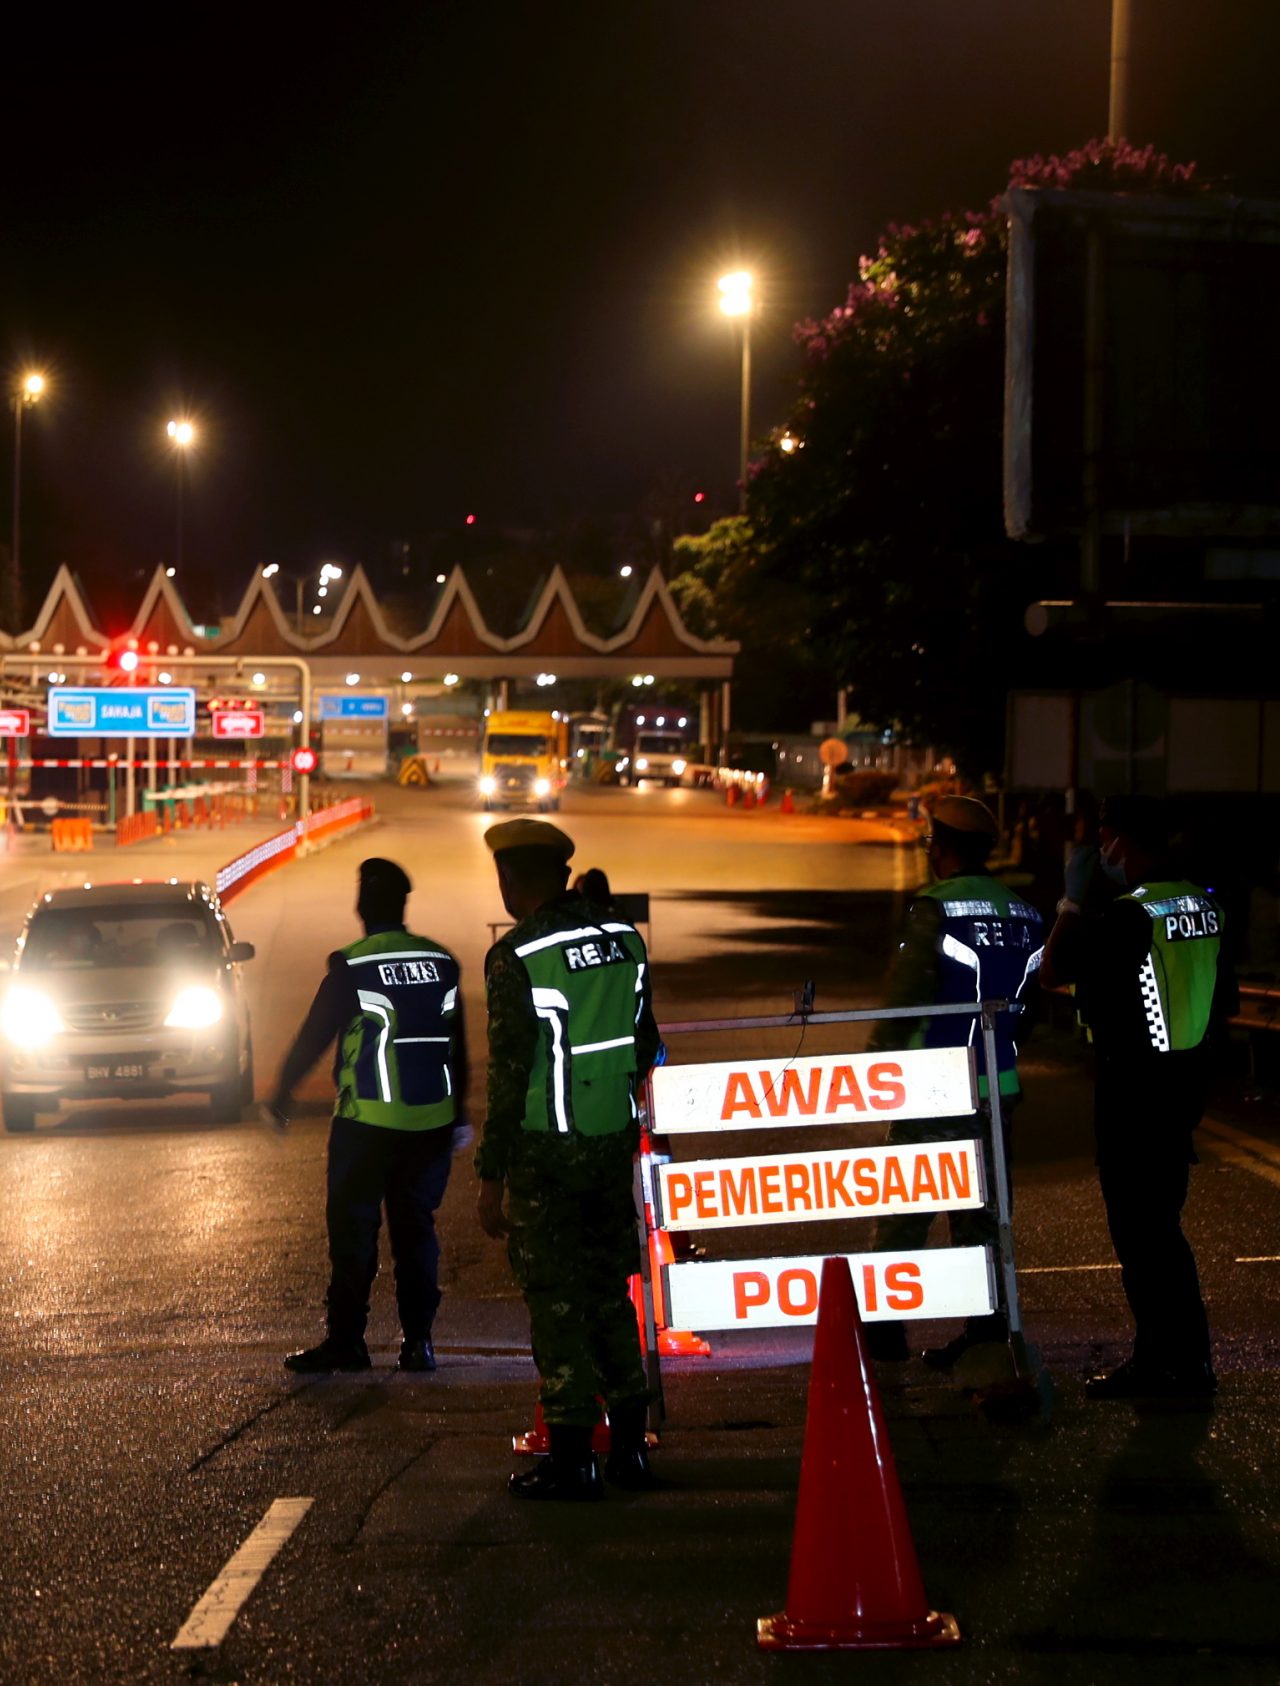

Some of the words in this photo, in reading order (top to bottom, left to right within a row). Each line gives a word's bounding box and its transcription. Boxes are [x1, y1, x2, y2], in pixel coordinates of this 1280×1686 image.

[973, 922, 1032, 950] RELA
[1165, 910, 1219, 940] POLIS
[564, 940, 625, 969] RELA
[380, 961, 438, 984] POLIS
[720, 1062, 906, 1121] AWAS
[666, 1151, 971, 1221] PEMERIKSAAN
[733, 1262, 925, 1319] POIS
